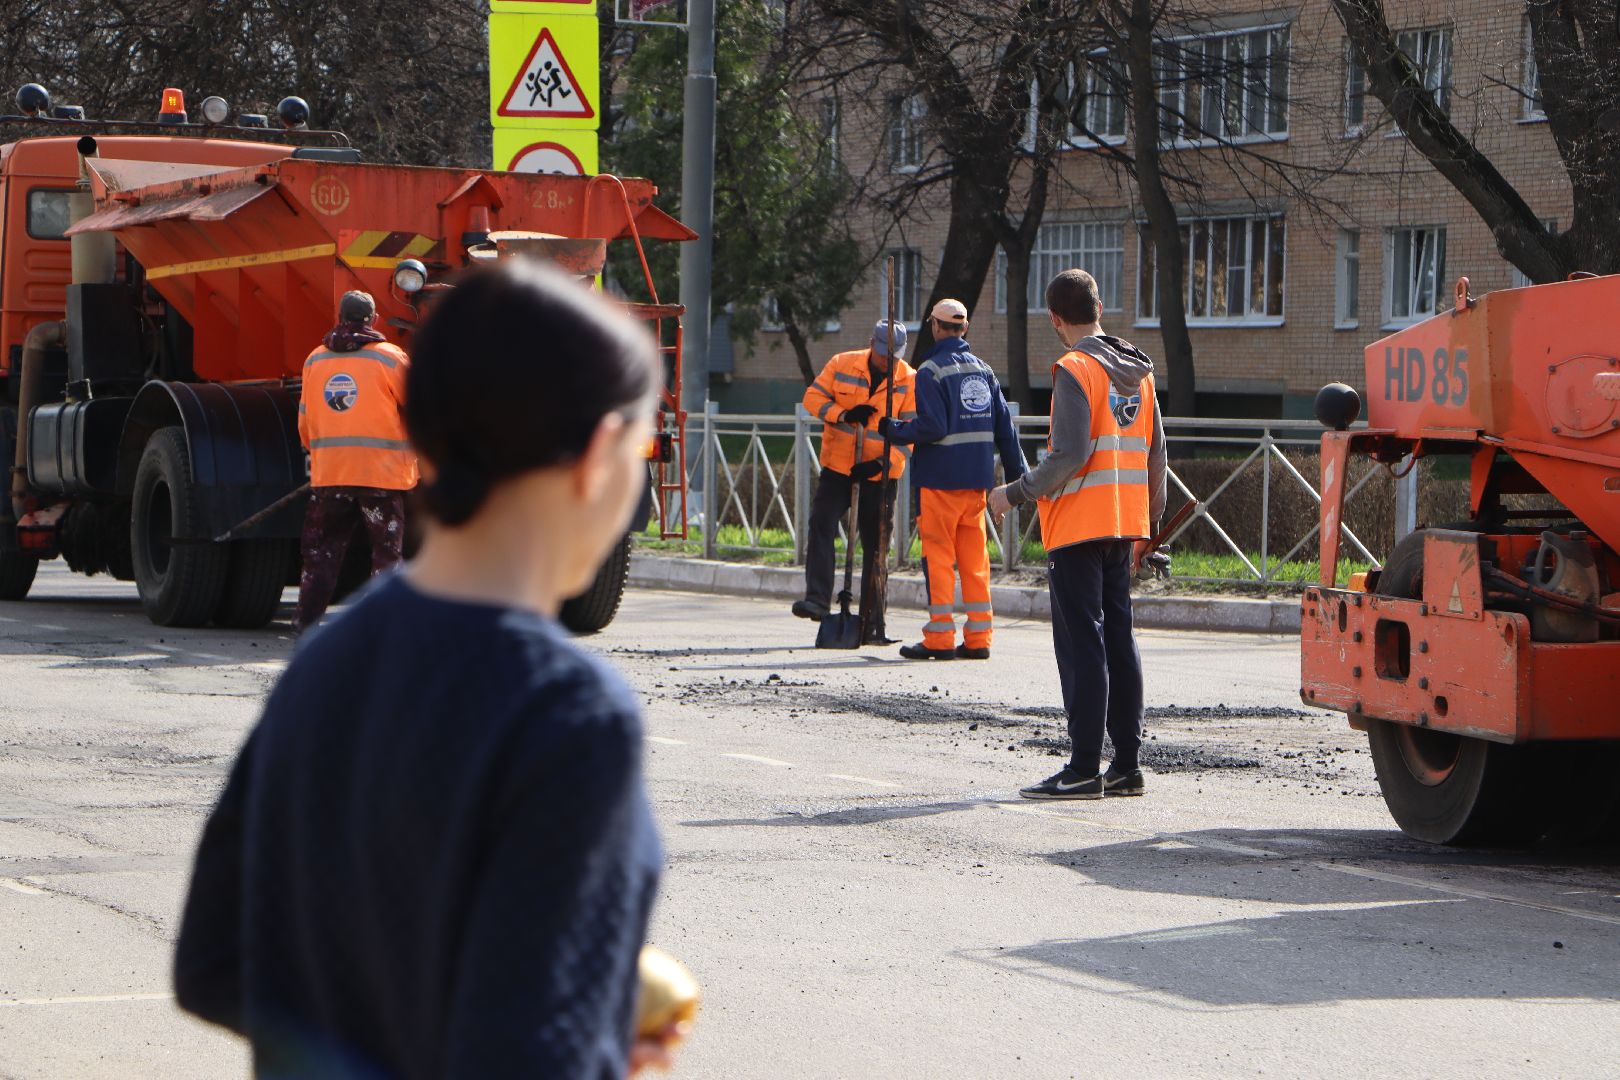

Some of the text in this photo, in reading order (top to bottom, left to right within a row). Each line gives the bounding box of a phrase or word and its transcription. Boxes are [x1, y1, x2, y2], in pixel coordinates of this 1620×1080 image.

[318, 185, 342, 206] 60
[1384, 346, 1469, 407] HD 85
